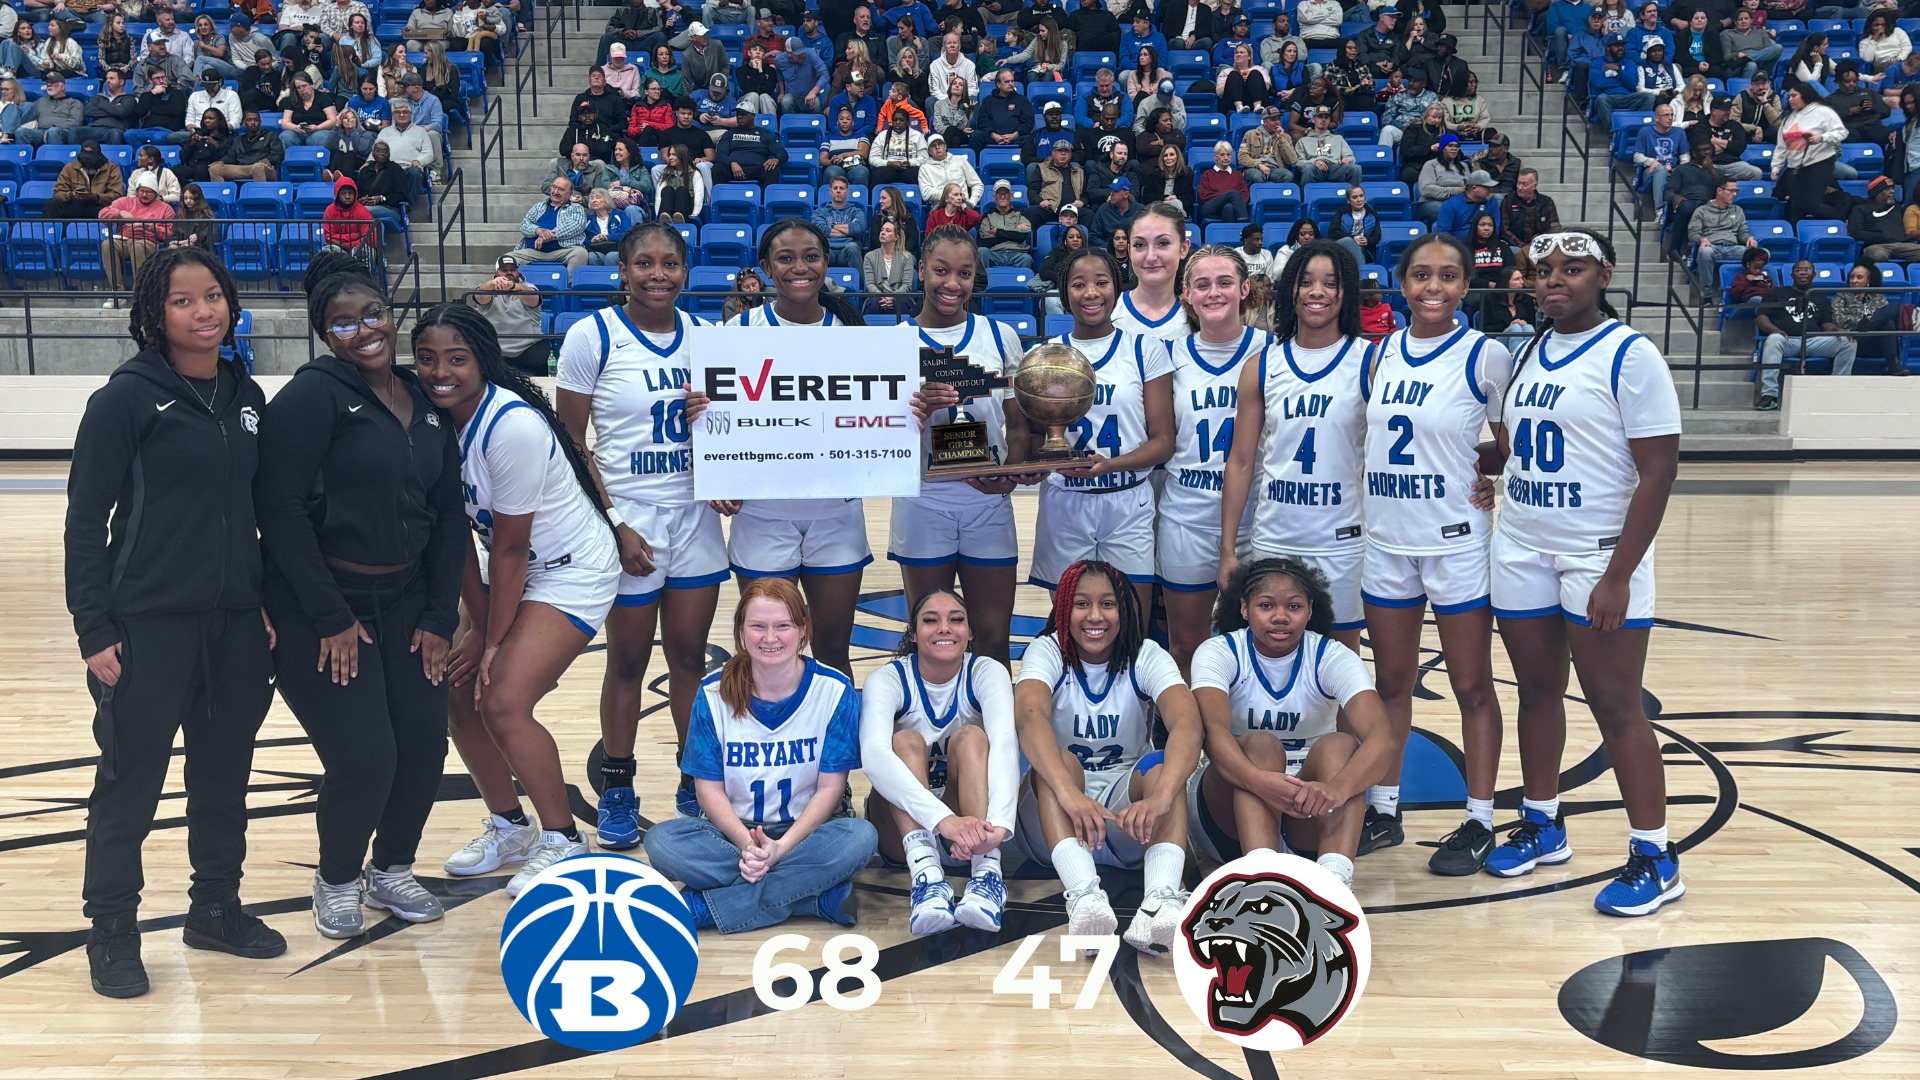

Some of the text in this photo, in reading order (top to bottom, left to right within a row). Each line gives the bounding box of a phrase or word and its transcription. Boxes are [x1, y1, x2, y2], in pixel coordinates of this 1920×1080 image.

[922, 358, 949, 367] SALINE
[935, 368, 965, 377] COUNTY
[705, 358, 906, 401] EVERETT
[1283, 394, 1333, 420] LADY
[1381, 380, 1434, 407] LADY
[1514, 382, 1566, 410] LADY
[650, 399, 691, 444] 10
[737, 415, 907, 428] BUICK GMC
[944, 431, 977, 440] SENIOR
[948, 440, 974, 449] GIRLS
[1068, 414, 1122, 459] 24
[1196, 417, 1235, 463] 14
[1387, 414, 1415, 465] 2
[1513, 417, 1565, 473] 40
[630, 447, 693, 475] HORNE
[704, 449, 912, 462] everettbgmc.com 501-315-7100
[938, 448, 985, 460] CHAMPION
[1293, 427, 1316, 475] 4
[1178, 468, 1224, 491] HORN
[1268, 479, 1342, 506] HORNETS
[1367, 472, 1446, 499] HORNETS
[1508, 475, 1582, 508] HORNETS
[1073, 713, 1120, 739] LADY
[1248, 707, 1301, 731] LADY
[725, 736, 817, 768] BRYANT
[750, 778, 795, 823] 11
